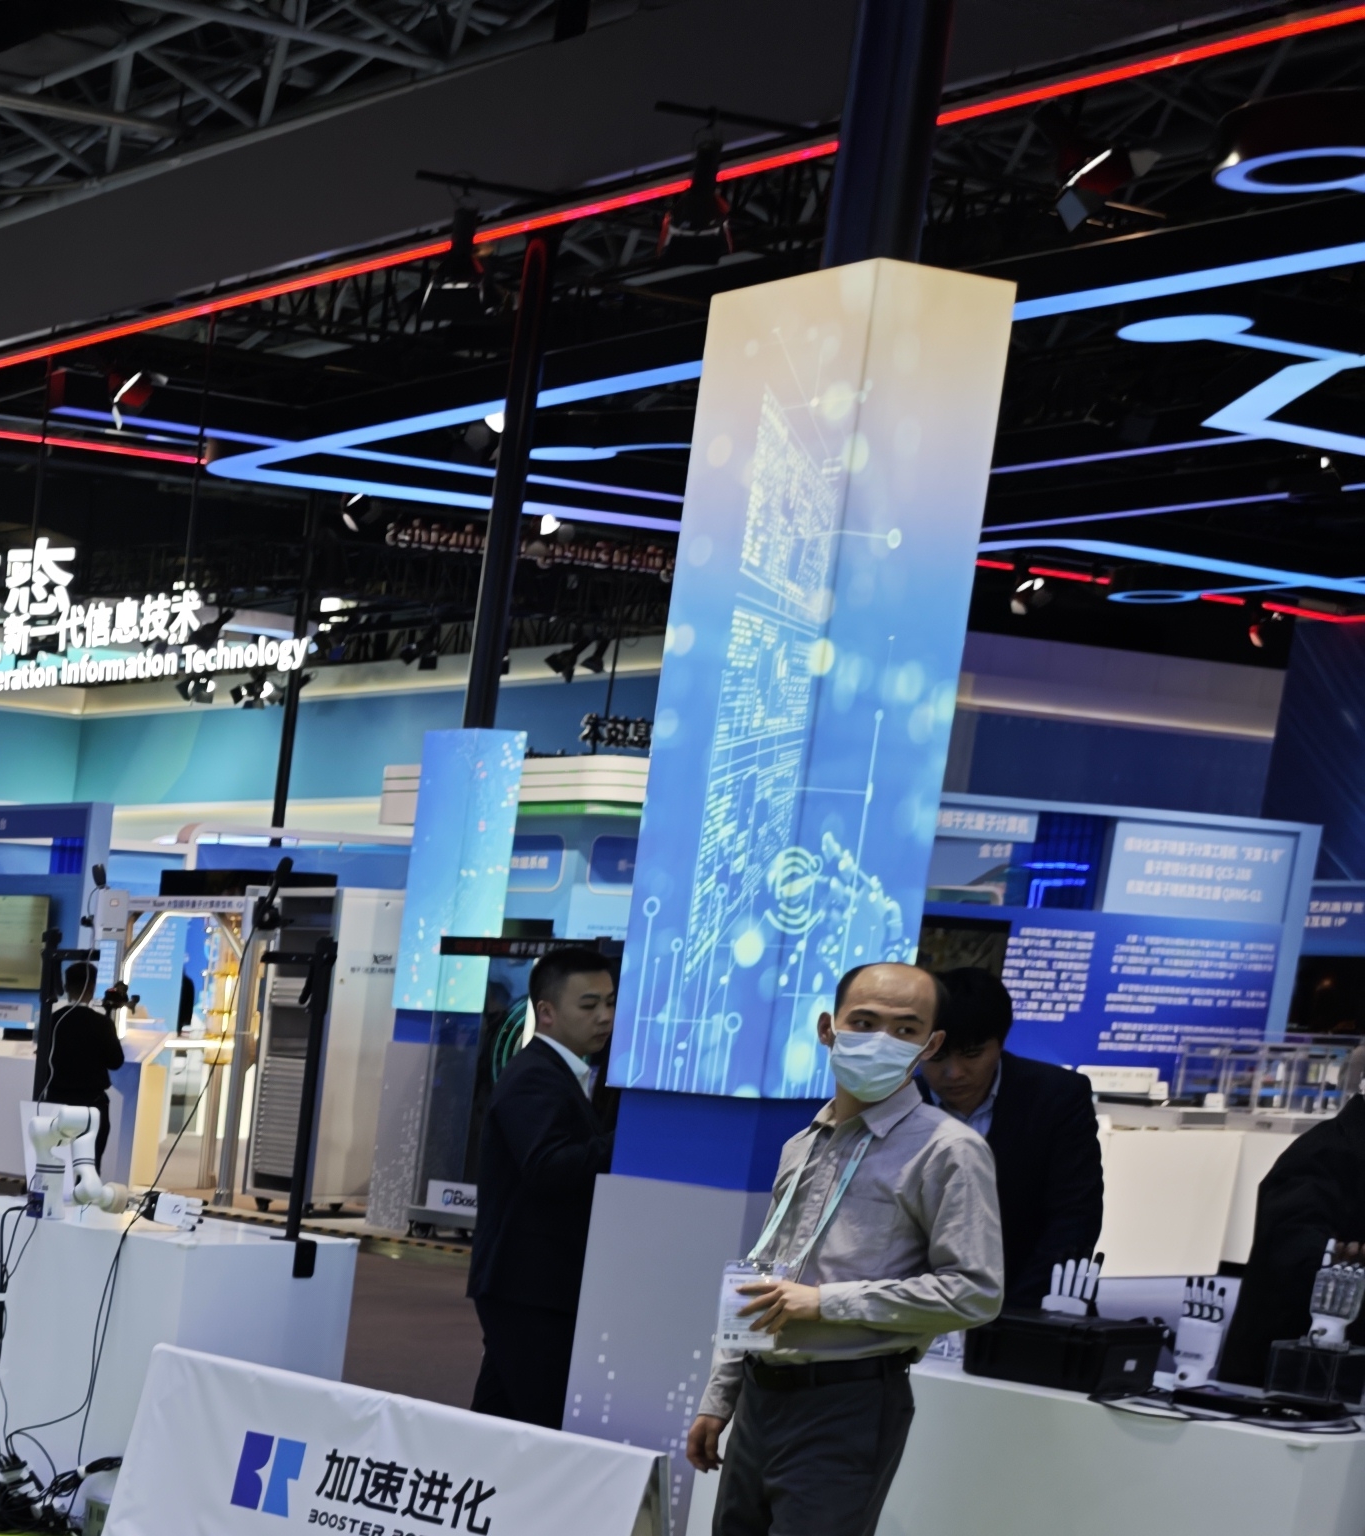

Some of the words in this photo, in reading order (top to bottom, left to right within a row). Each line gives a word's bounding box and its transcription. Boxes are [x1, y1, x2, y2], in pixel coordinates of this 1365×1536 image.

[3, 589, 203, 656] 新一代信息技术
[60, 649, 177, 685] Information
[181, 635, 310, 674] Technology
[315, 1447, 497, 1536] 加速进化
